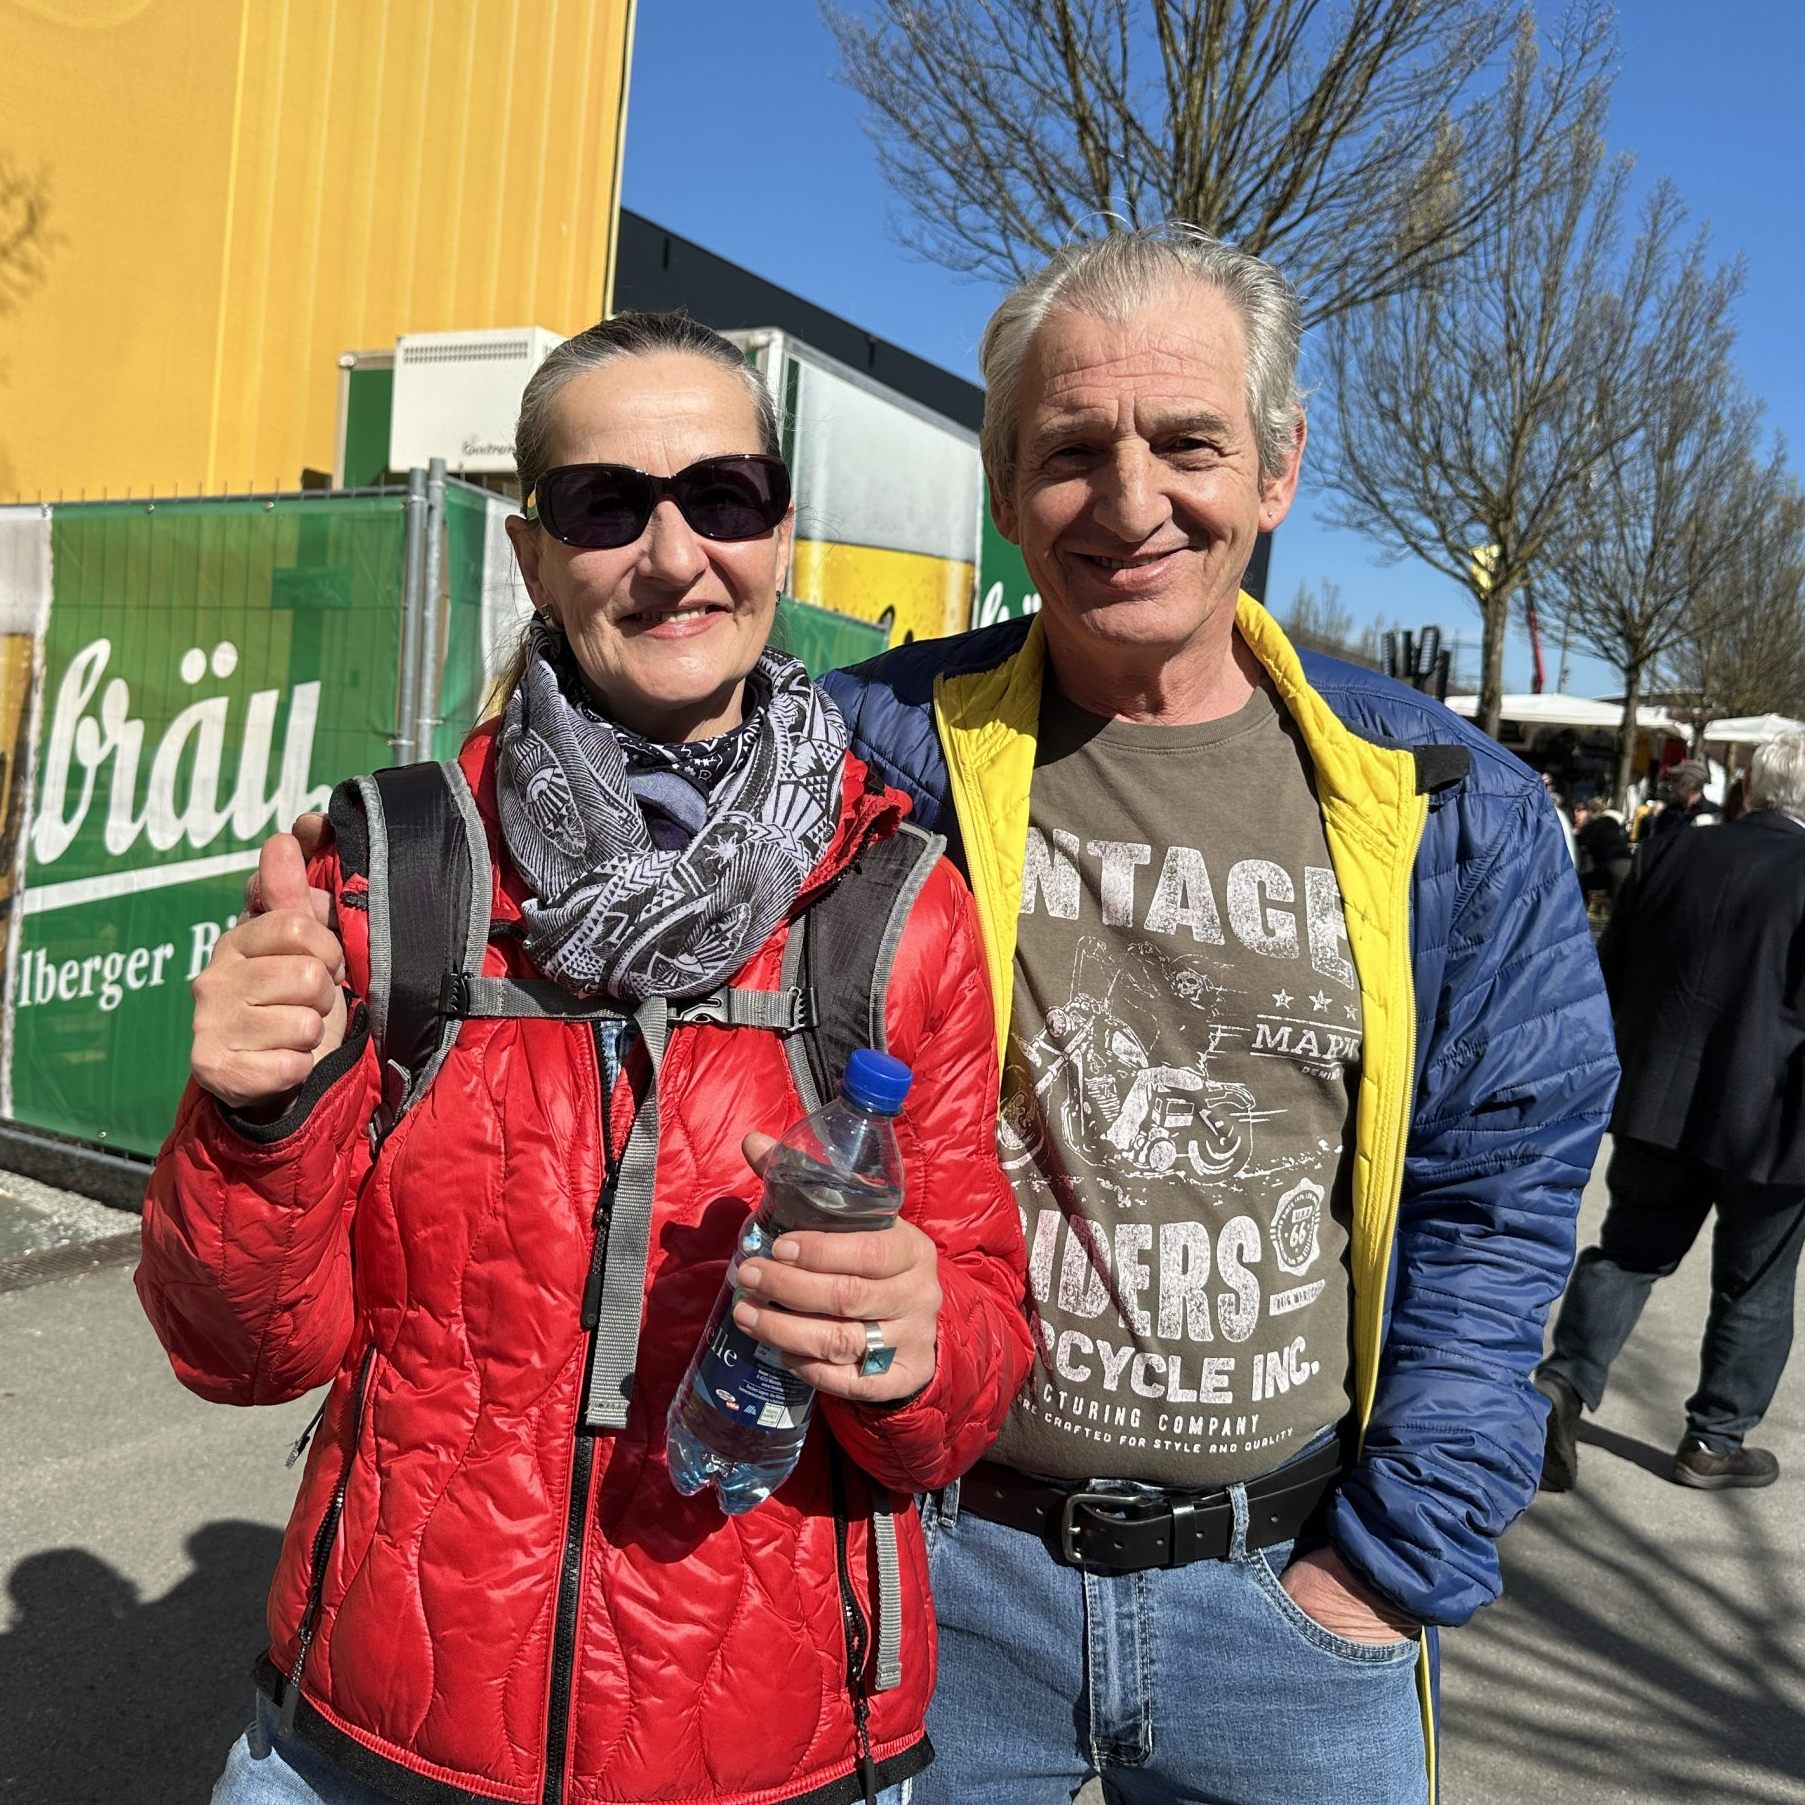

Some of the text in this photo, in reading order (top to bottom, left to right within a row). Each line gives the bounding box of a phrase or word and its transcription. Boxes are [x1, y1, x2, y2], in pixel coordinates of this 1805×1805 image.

[31, 638, 333, 865] bräu
[17, 915, 239, 1012] lberger B
[1289, 1221, 1306, 1248] 66
[1018, 1205, 1262, 1343] IDERS
[1251, 1335, 1320, 1402] INC.
[1044, 1412, 1112, 1443] CRAFTED
[1119, 1435, 1146, 1448] FOR
[1153, 1438, 1201, 1453] STYLE
[1209, 1443, 1238, 1454] AND
[1244, 1427, 1294, 1451] QUALITY
[1158, 1413, 1260, 1437] COMPANY
